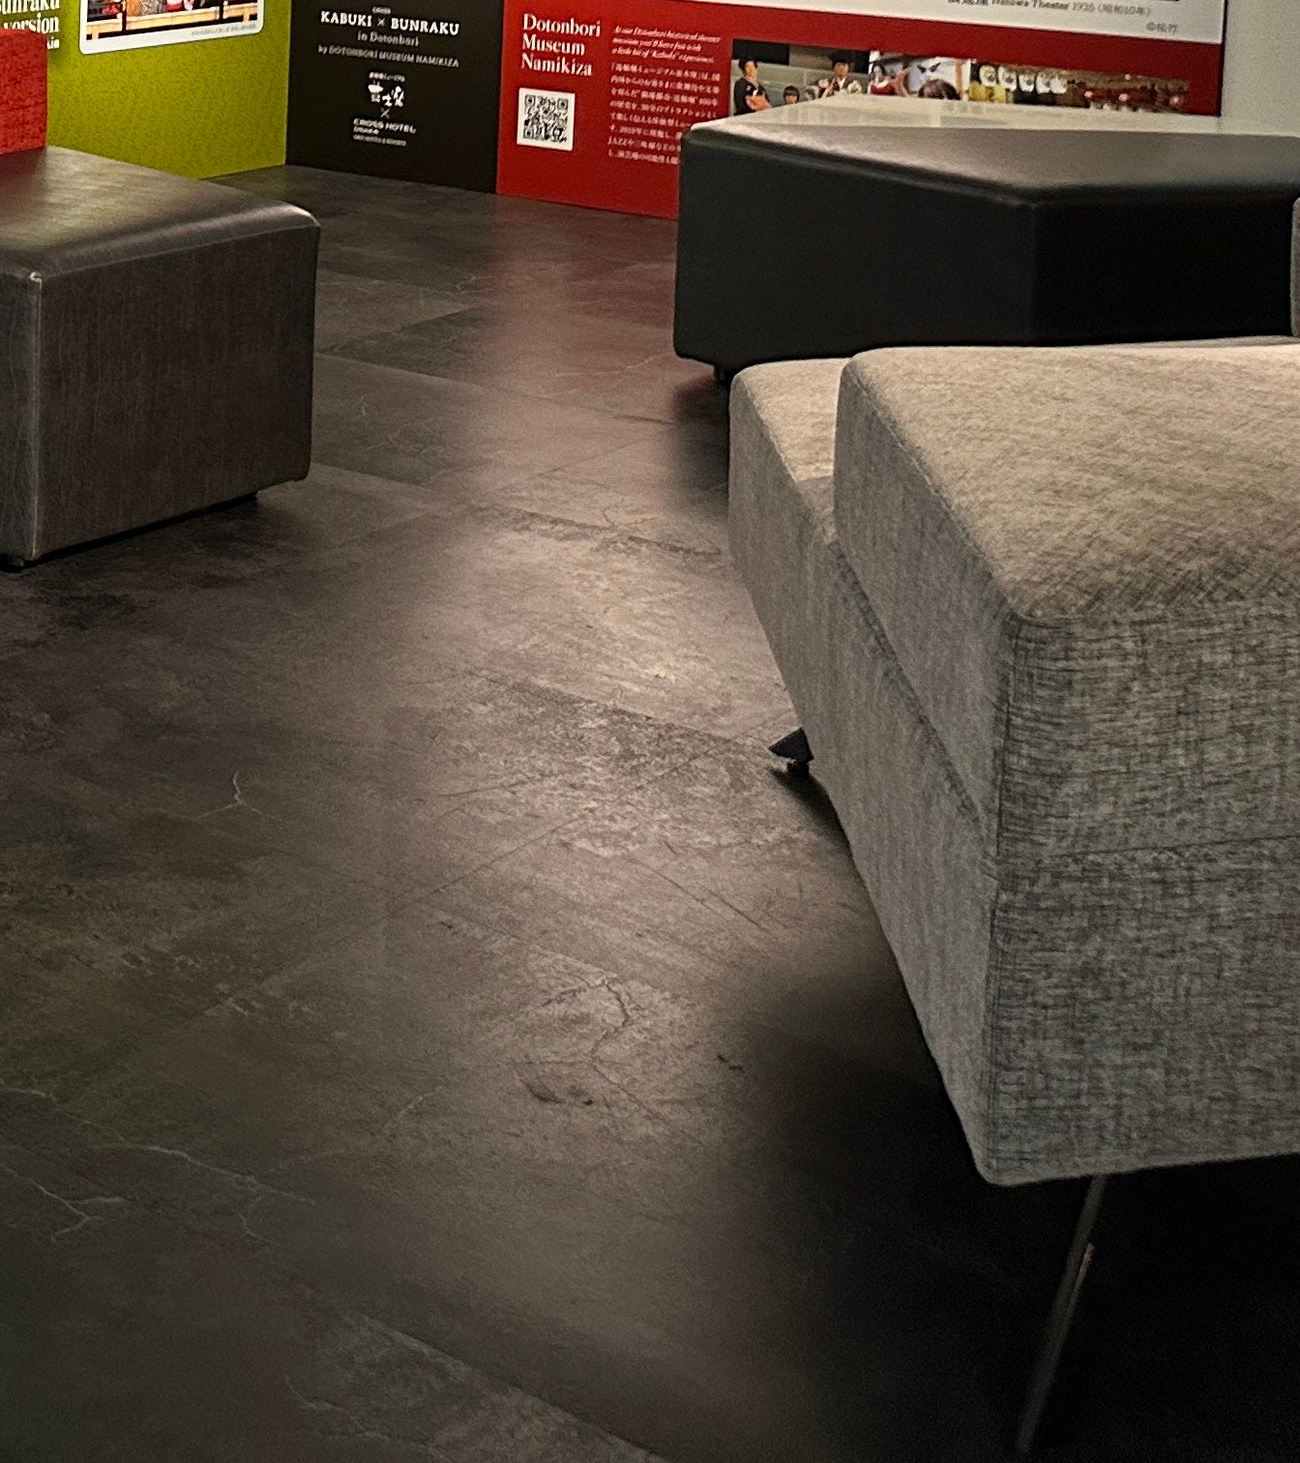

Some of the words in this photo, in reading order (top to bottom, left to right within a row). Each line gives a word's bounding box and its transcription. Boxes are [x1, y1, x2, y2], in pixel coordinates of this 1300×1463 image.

[320, 10, 372, 27] KABUKI
[391, 16, 460, 35] BUNRAKU
[523, 13, 600, 37] Dotonbori
[523, 34, 585, 55] Museum
[521, 53, 592, 77] Namikiza
